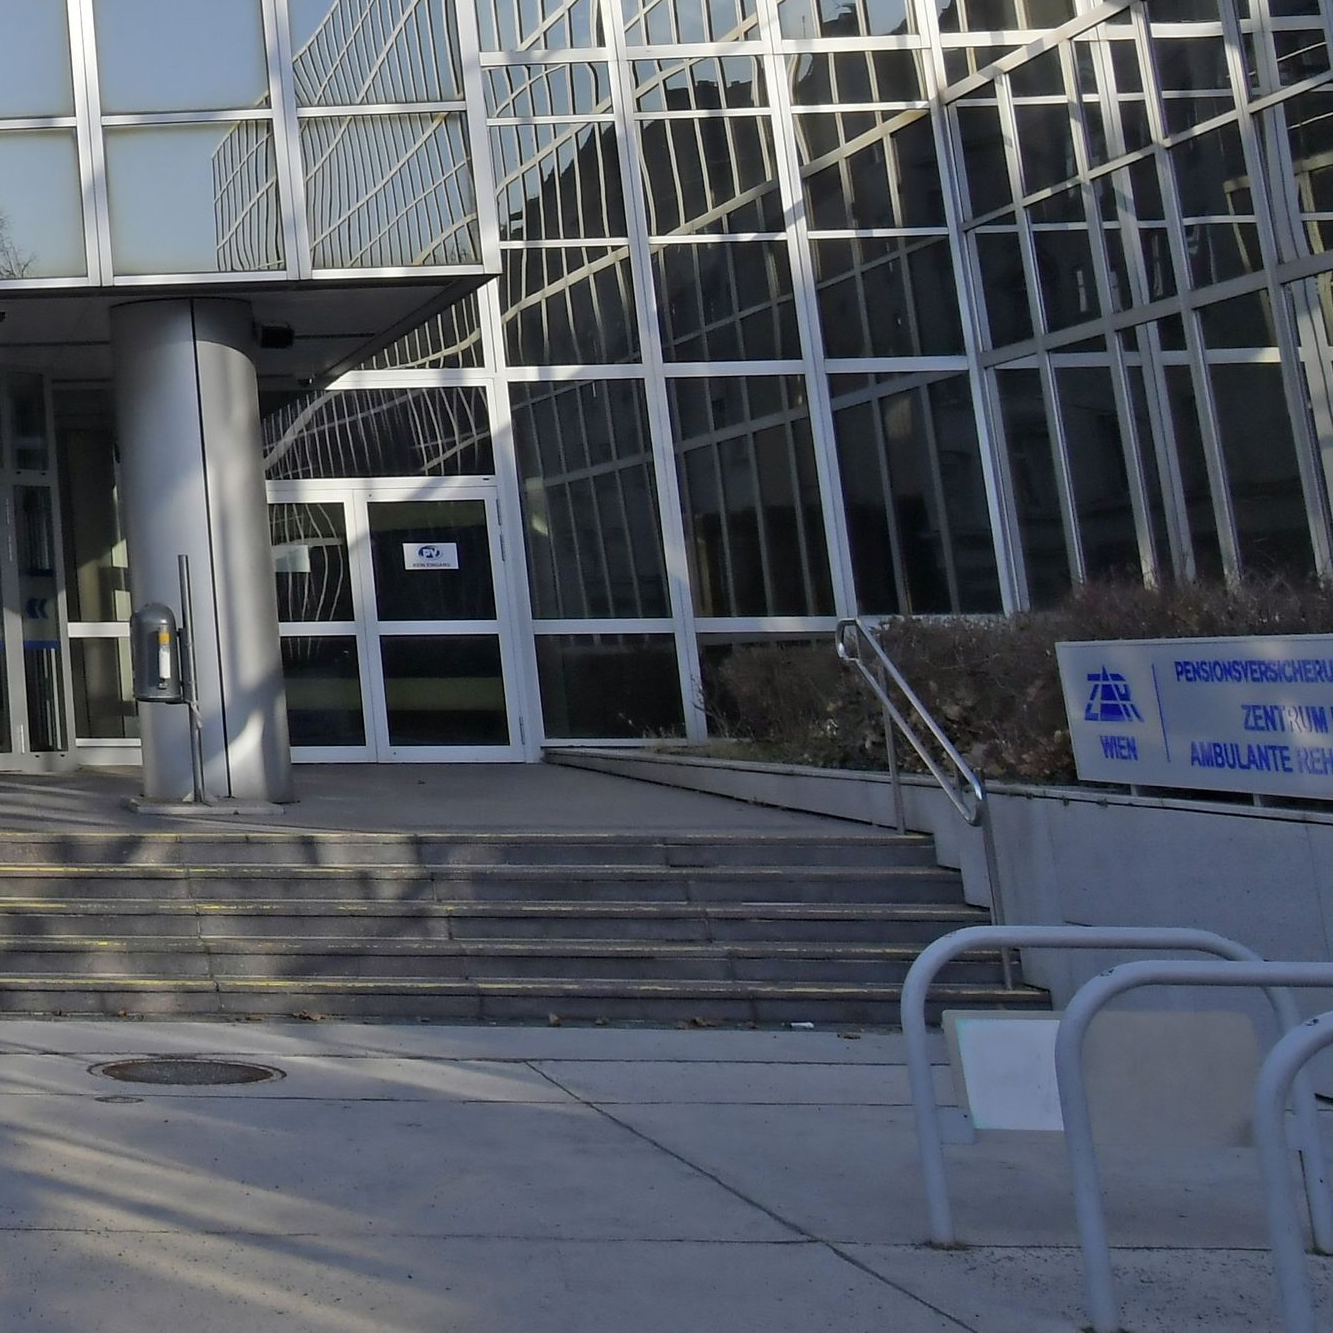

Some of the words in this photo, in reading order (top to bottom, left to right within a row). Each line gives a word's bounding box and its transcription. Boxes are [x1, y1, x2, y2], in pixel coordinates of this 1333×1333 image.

[1241, 704, 1329, 734] ZENTRUM
[1099, 734, 1138, 761] WIEN
[1190, 740, 1293, 773] AMBULANTE
